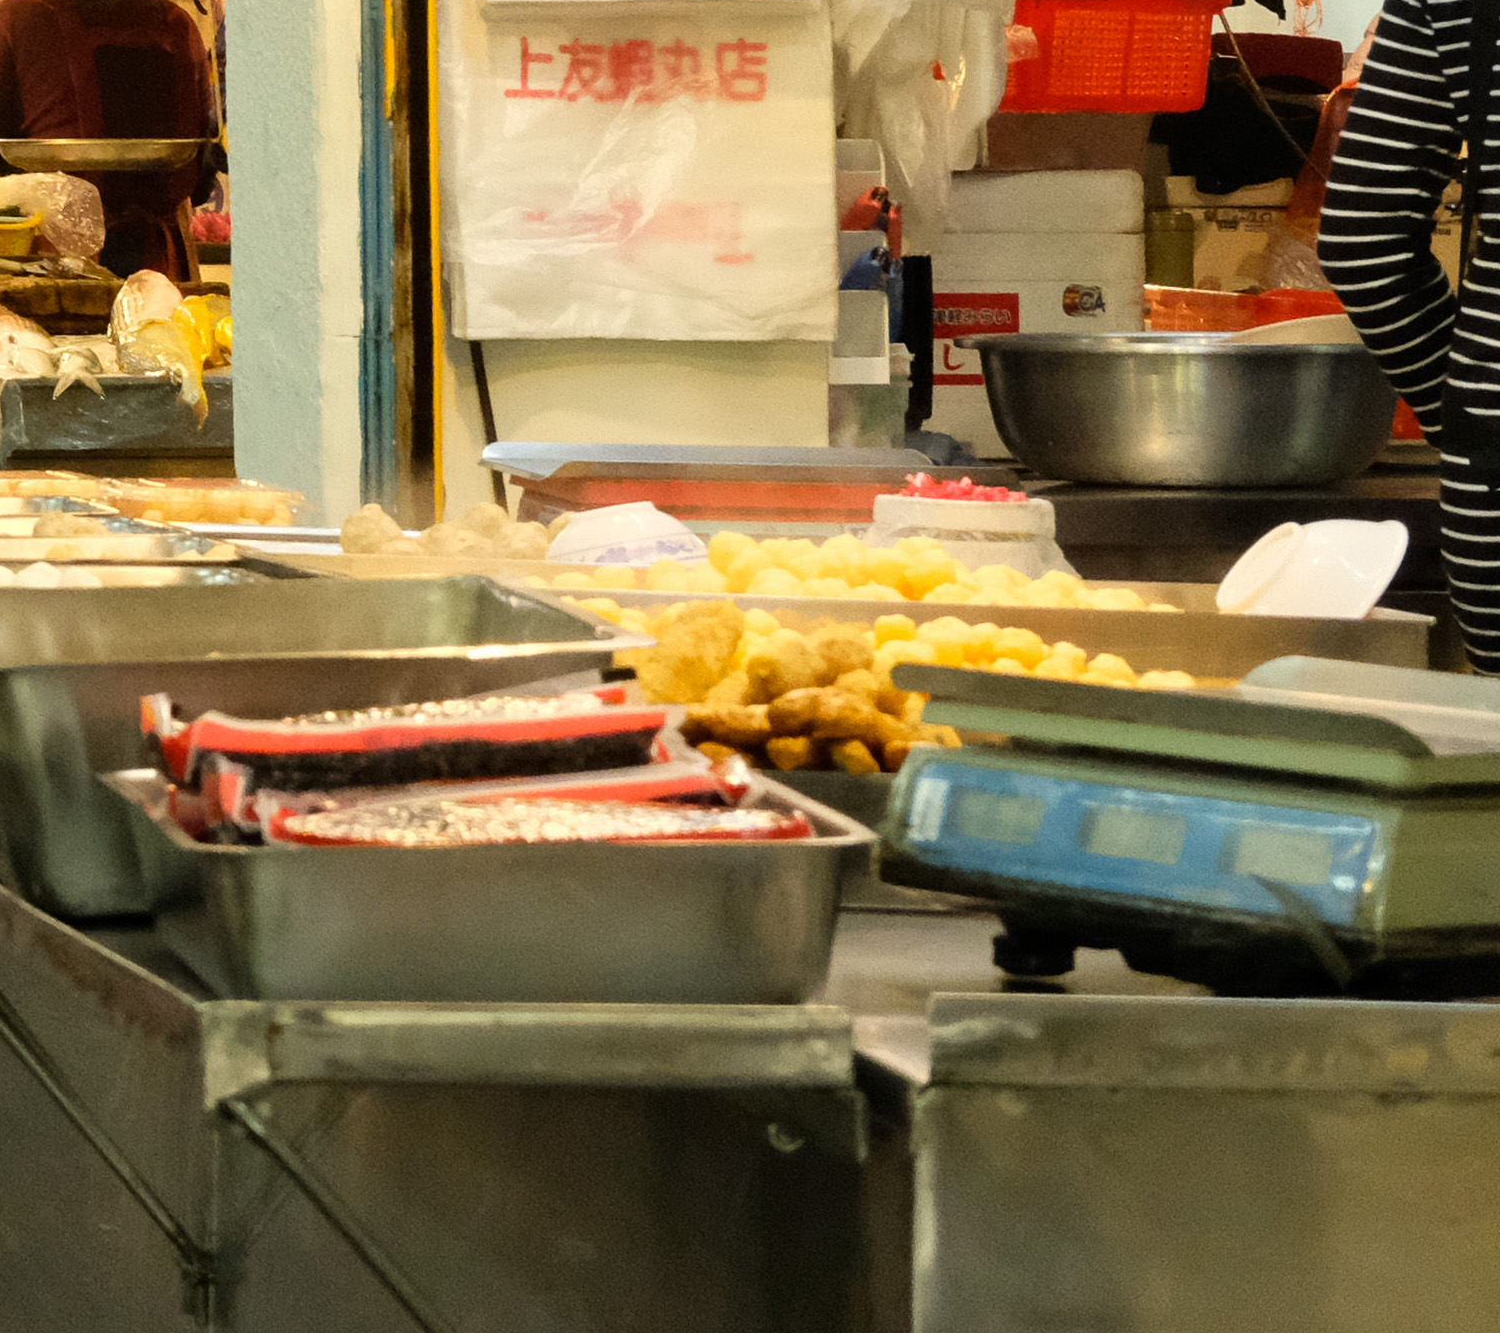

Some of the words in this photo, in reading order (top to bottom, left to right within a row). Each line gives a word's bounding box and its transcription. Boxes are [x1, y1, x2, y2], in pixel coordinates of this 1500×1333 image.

[504, 37, 769, 103] 上友蝦丸店
